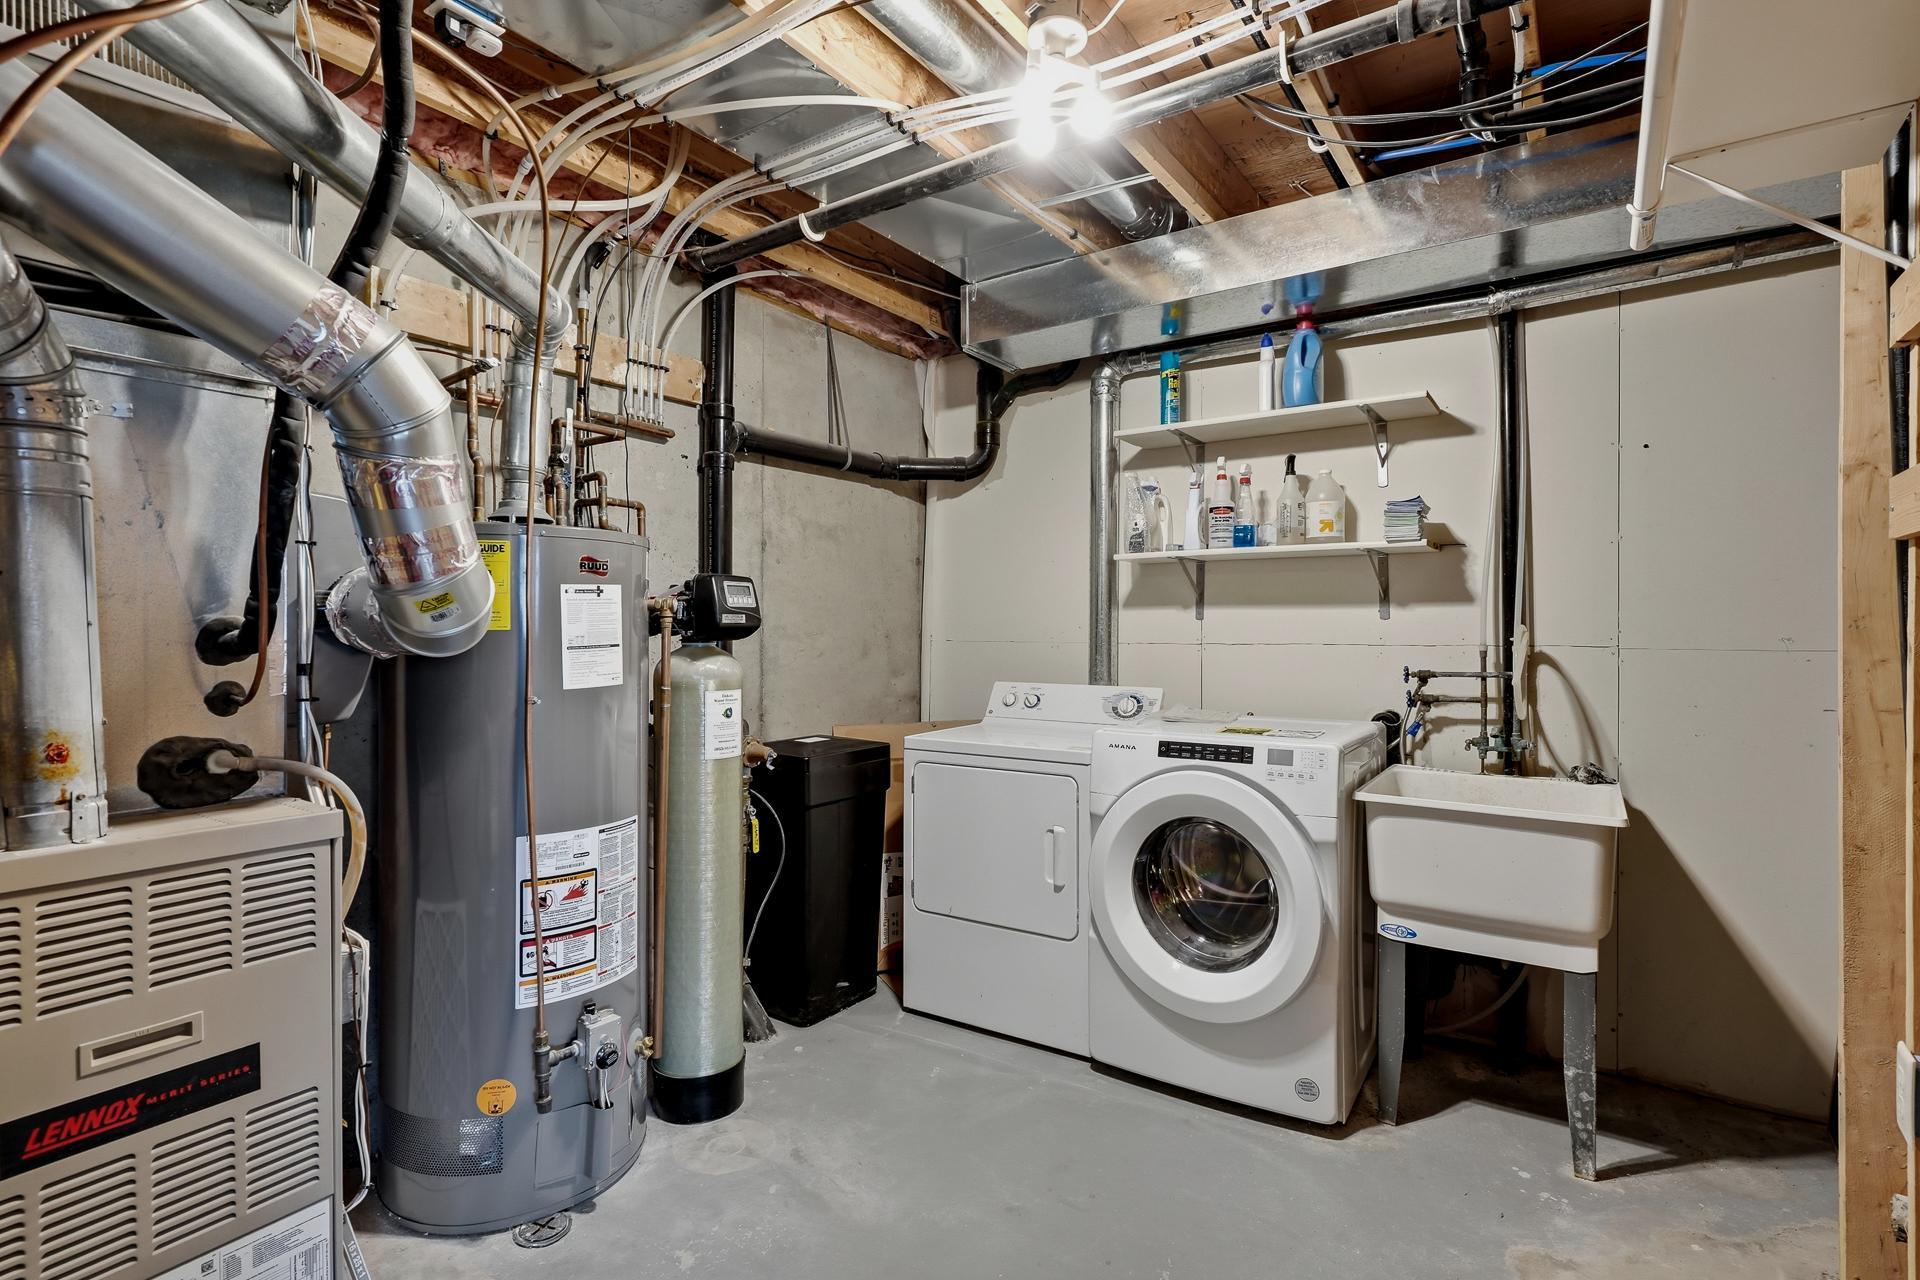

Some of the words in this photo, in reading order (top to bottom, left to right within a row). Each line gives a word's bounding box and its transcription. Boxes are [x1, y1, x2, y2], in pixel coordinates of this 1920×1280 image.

[580, 562, 609, 570] RUUD
[1108, 743, 1137, 751] AMANA
[24, 1093, 146, 1152] LENNOX
[146, 1084, 193, 1105] MERIT
[199, 1064, 251, 1087] SERIES
